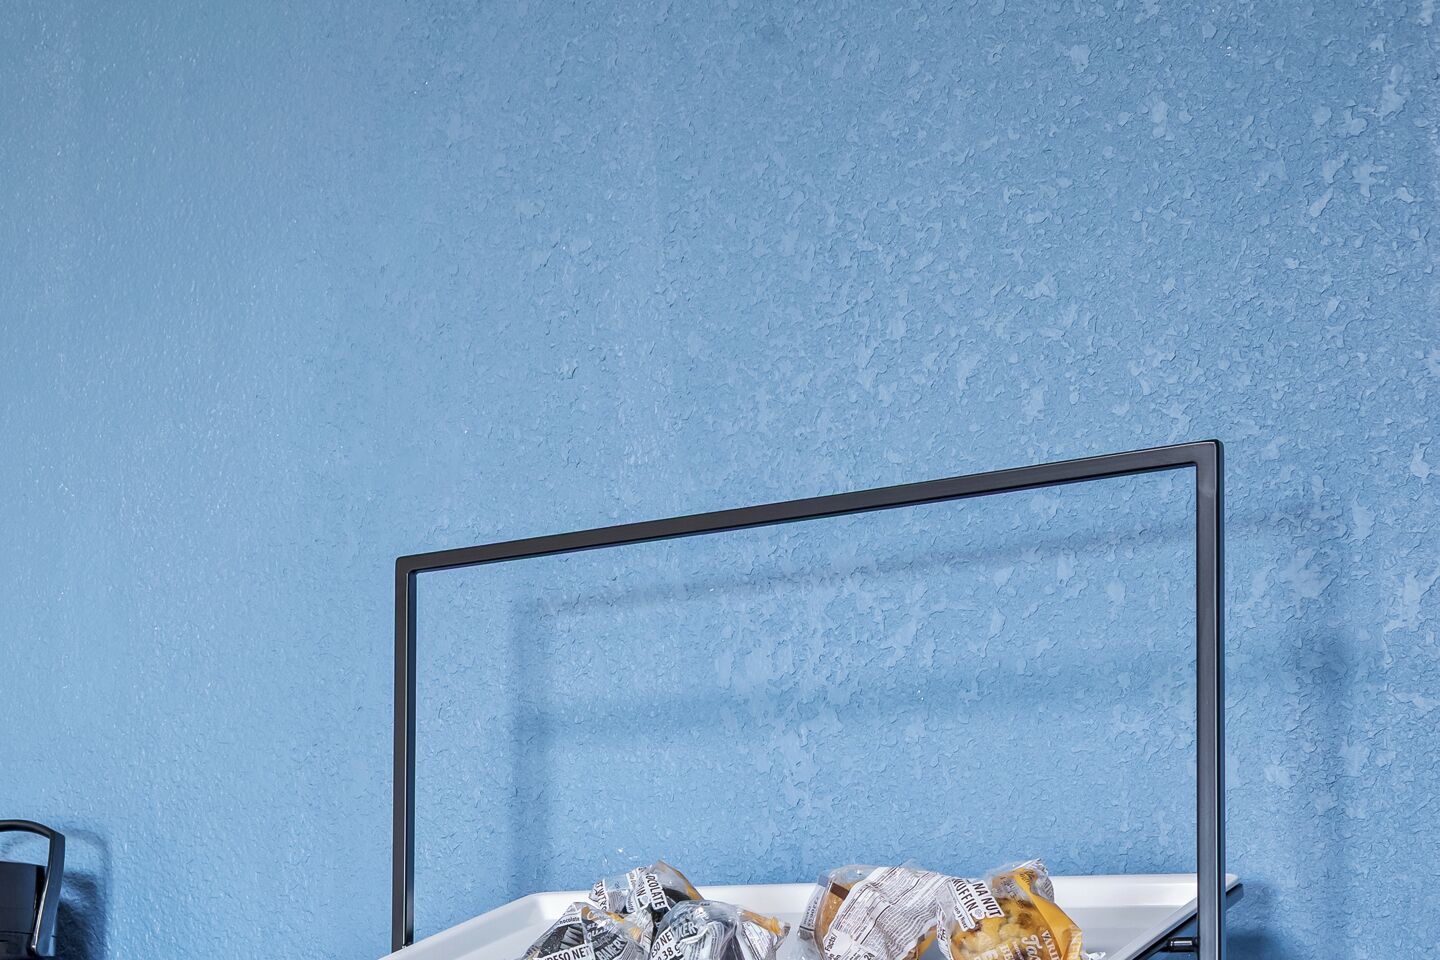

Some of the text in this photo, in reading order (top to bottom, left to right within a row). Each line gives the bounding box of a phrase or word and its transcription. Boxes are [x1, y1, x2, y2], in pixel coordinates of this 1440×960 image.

[951, 879, 978, 912] MUFFIN
[981, 897, 1002, 916] NUT
[571, 945, 592, 959] NET
